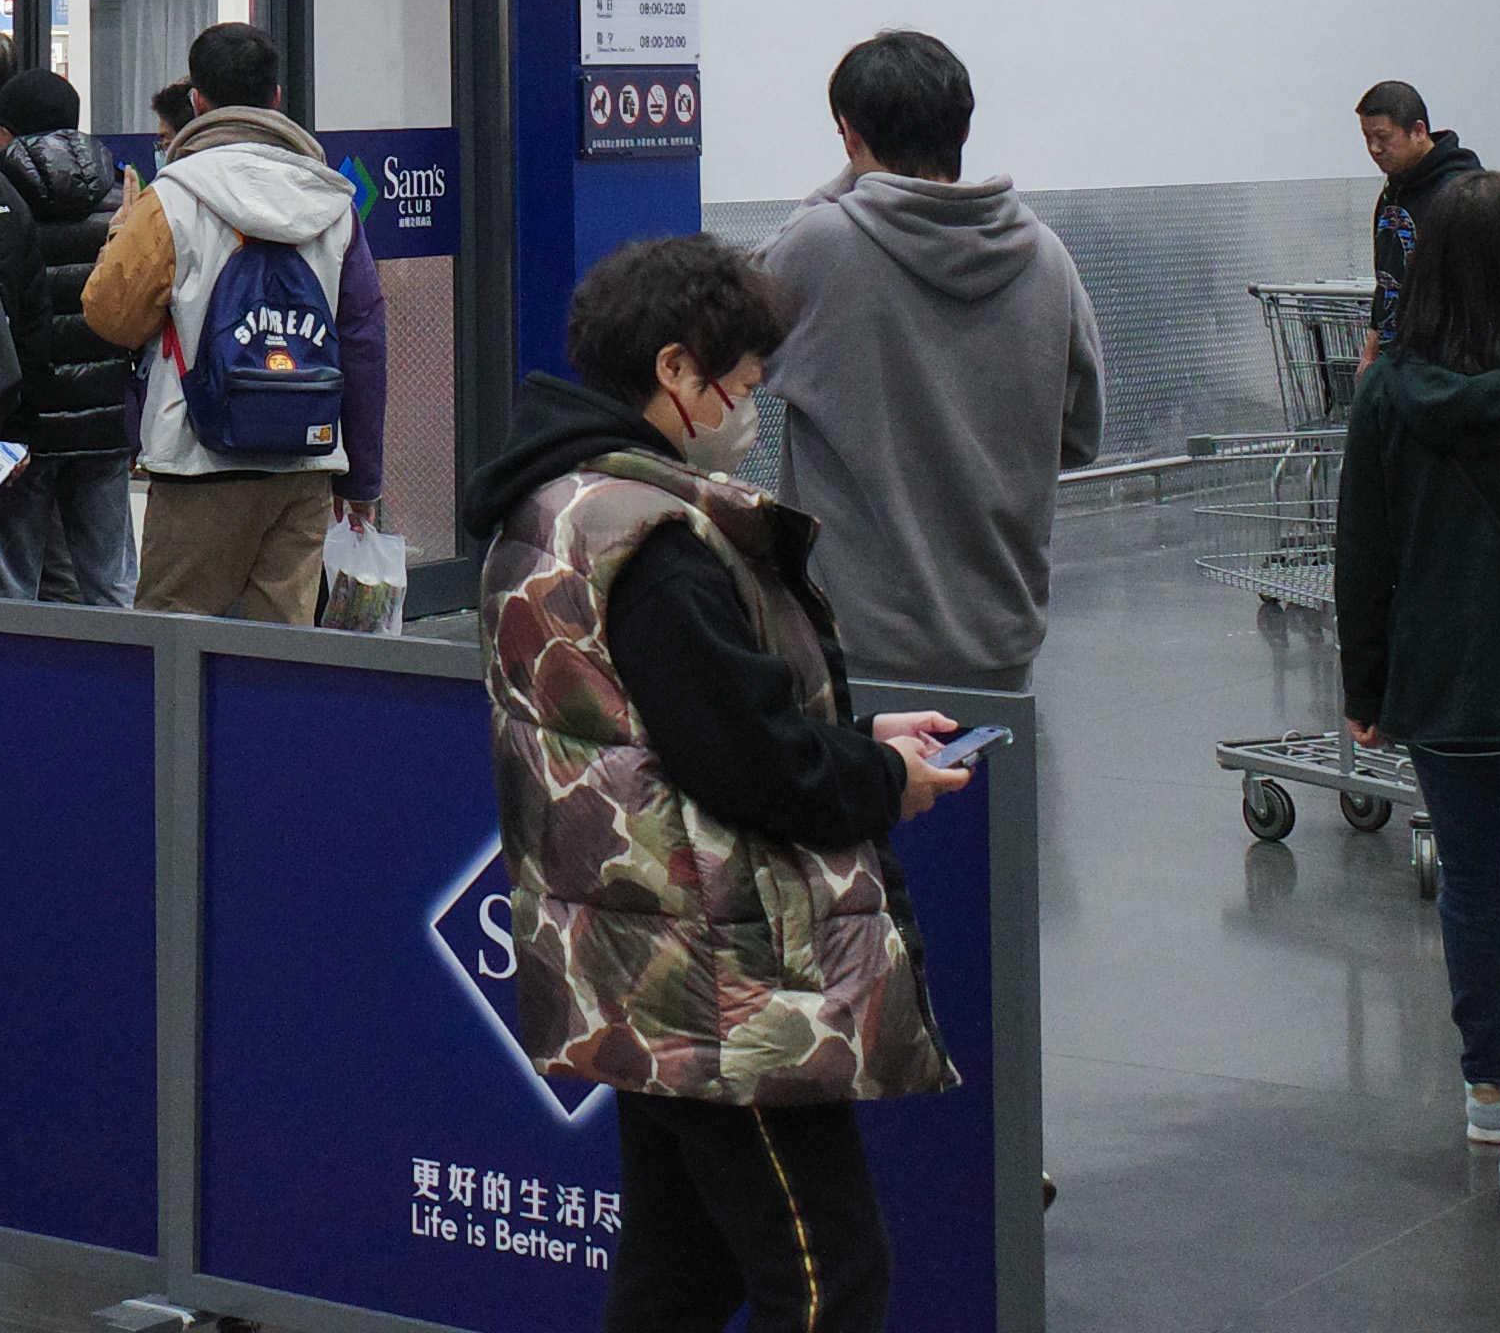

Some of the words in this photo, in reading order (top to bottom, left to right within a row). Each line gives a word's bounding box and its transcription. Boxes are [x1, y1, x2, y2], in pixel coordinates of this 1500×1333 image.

[383, 156, 446, 200] Sam's
[398, 199, 432, 215] CLUB
[412, 1202, 458, 1241] Life
[467, 1212, 486, 1247] is
[495, 1217, 577, 1264] Better
[585, 1234, 609, 1271] in
